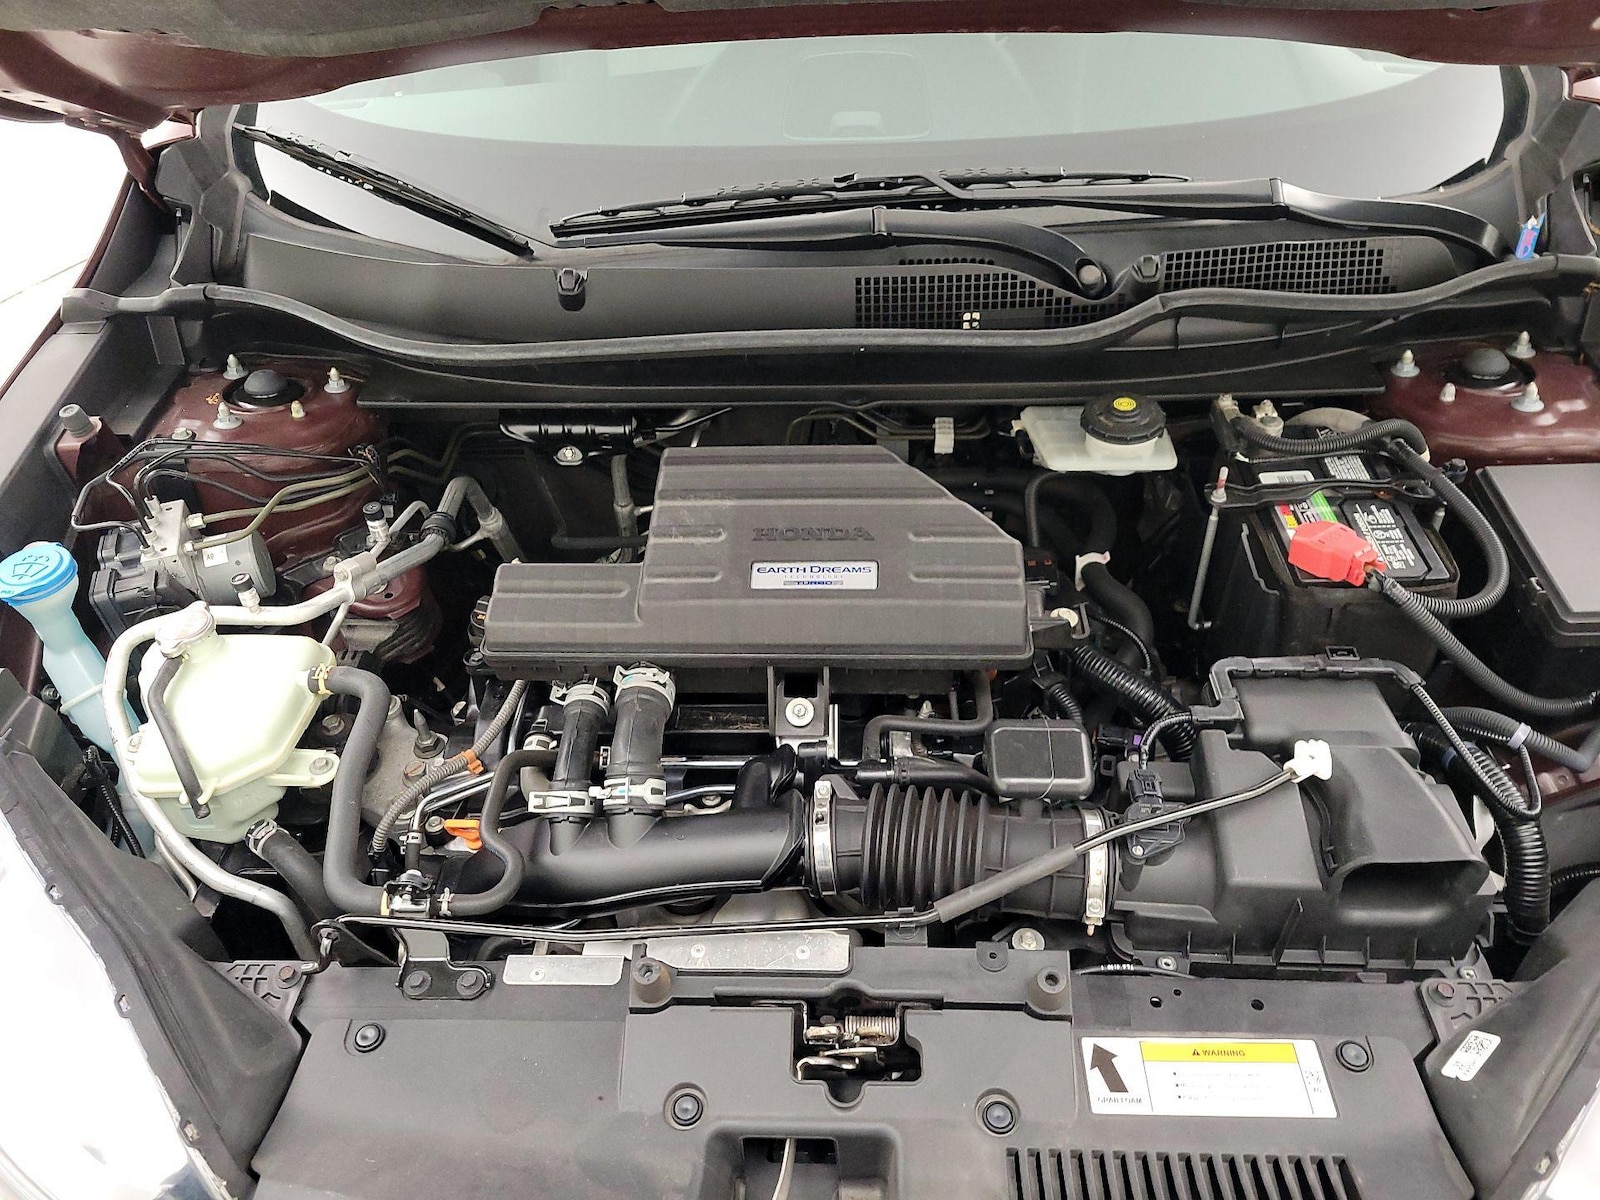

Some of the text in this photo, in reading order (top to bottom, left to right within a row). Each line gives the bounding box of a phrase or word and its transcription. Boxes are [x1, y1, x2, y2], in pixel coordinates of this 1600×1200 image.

[752, 526, 875, 541] HONDA
[756, 565, 872, 574] EARTH DREAMS
[1201, 1049, 1246, 1057] WARNING
